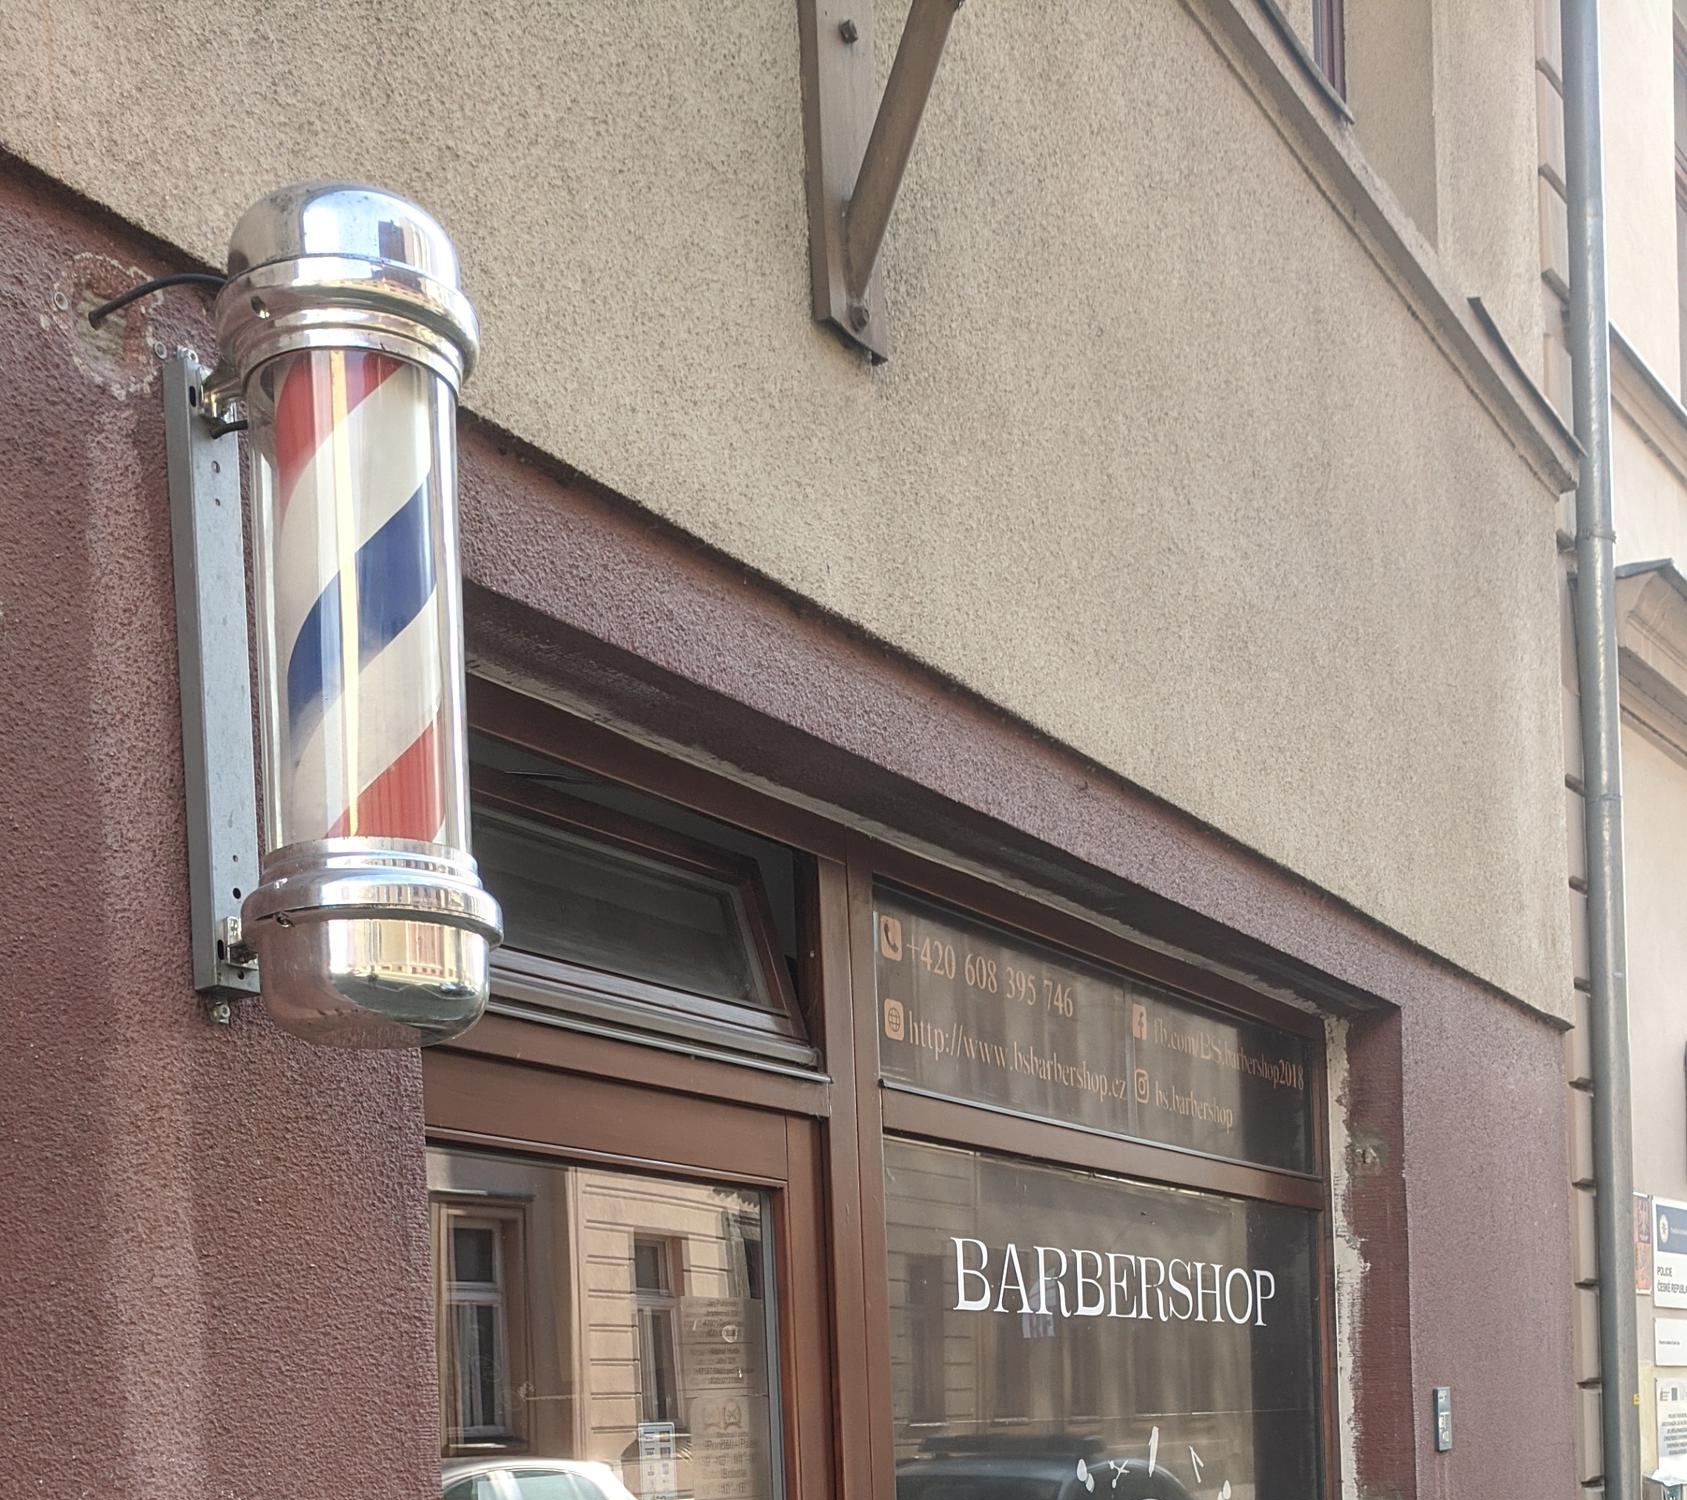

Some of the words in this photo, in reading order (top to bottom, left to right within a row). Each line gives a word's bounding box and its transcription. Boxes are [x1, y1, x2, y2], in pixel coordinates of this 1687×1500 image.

[906, 933, 956, 980] +420
[964, 953, 998, 994] 608
[1006, 966, 1037, 1006] 395
[1043, 979, 1074, 1018] 746
[908, 1010, 1126, 1101] http://www.bsbarbershop.cz
[1155, 1080, 1233, 1134] bs.barbershop
[950, 1236, 1276, 1327] BARBERSHOP
